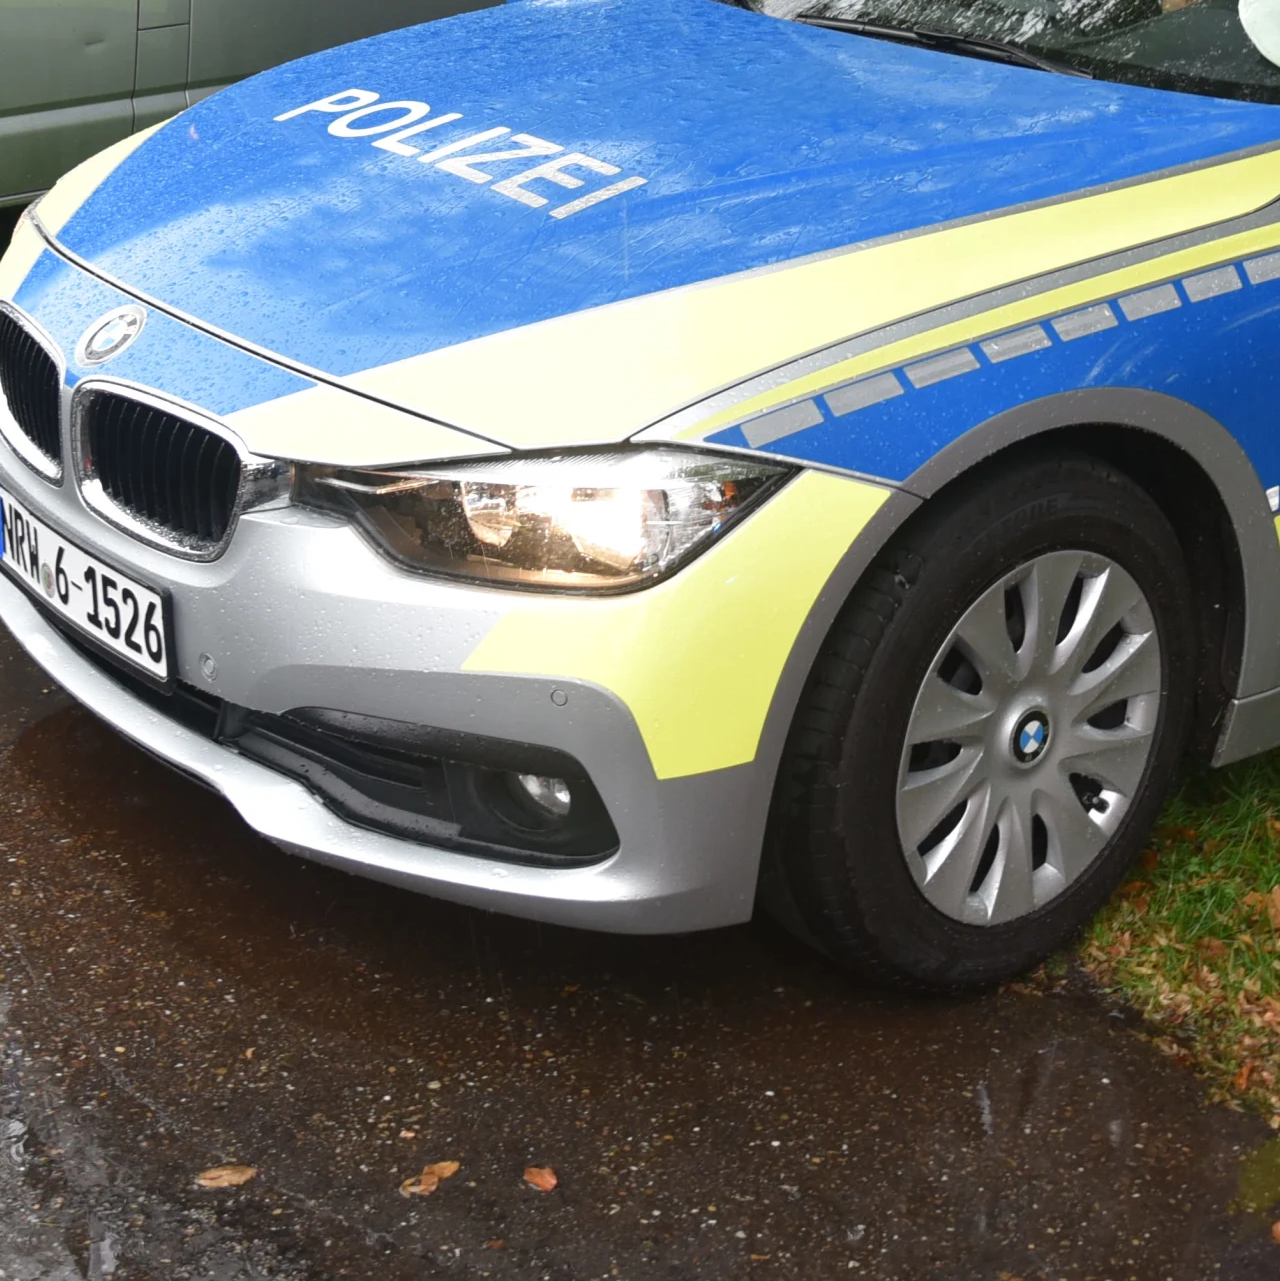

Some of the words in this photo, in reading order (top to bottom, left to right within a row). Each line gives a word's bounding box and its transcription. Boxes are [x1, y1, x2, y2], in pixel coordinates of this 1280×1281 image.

[273, 88, 648, 219] POLIZEI
[0, 496, 41, 575] NRW
[55, 545, 163, 665] 6-1526
